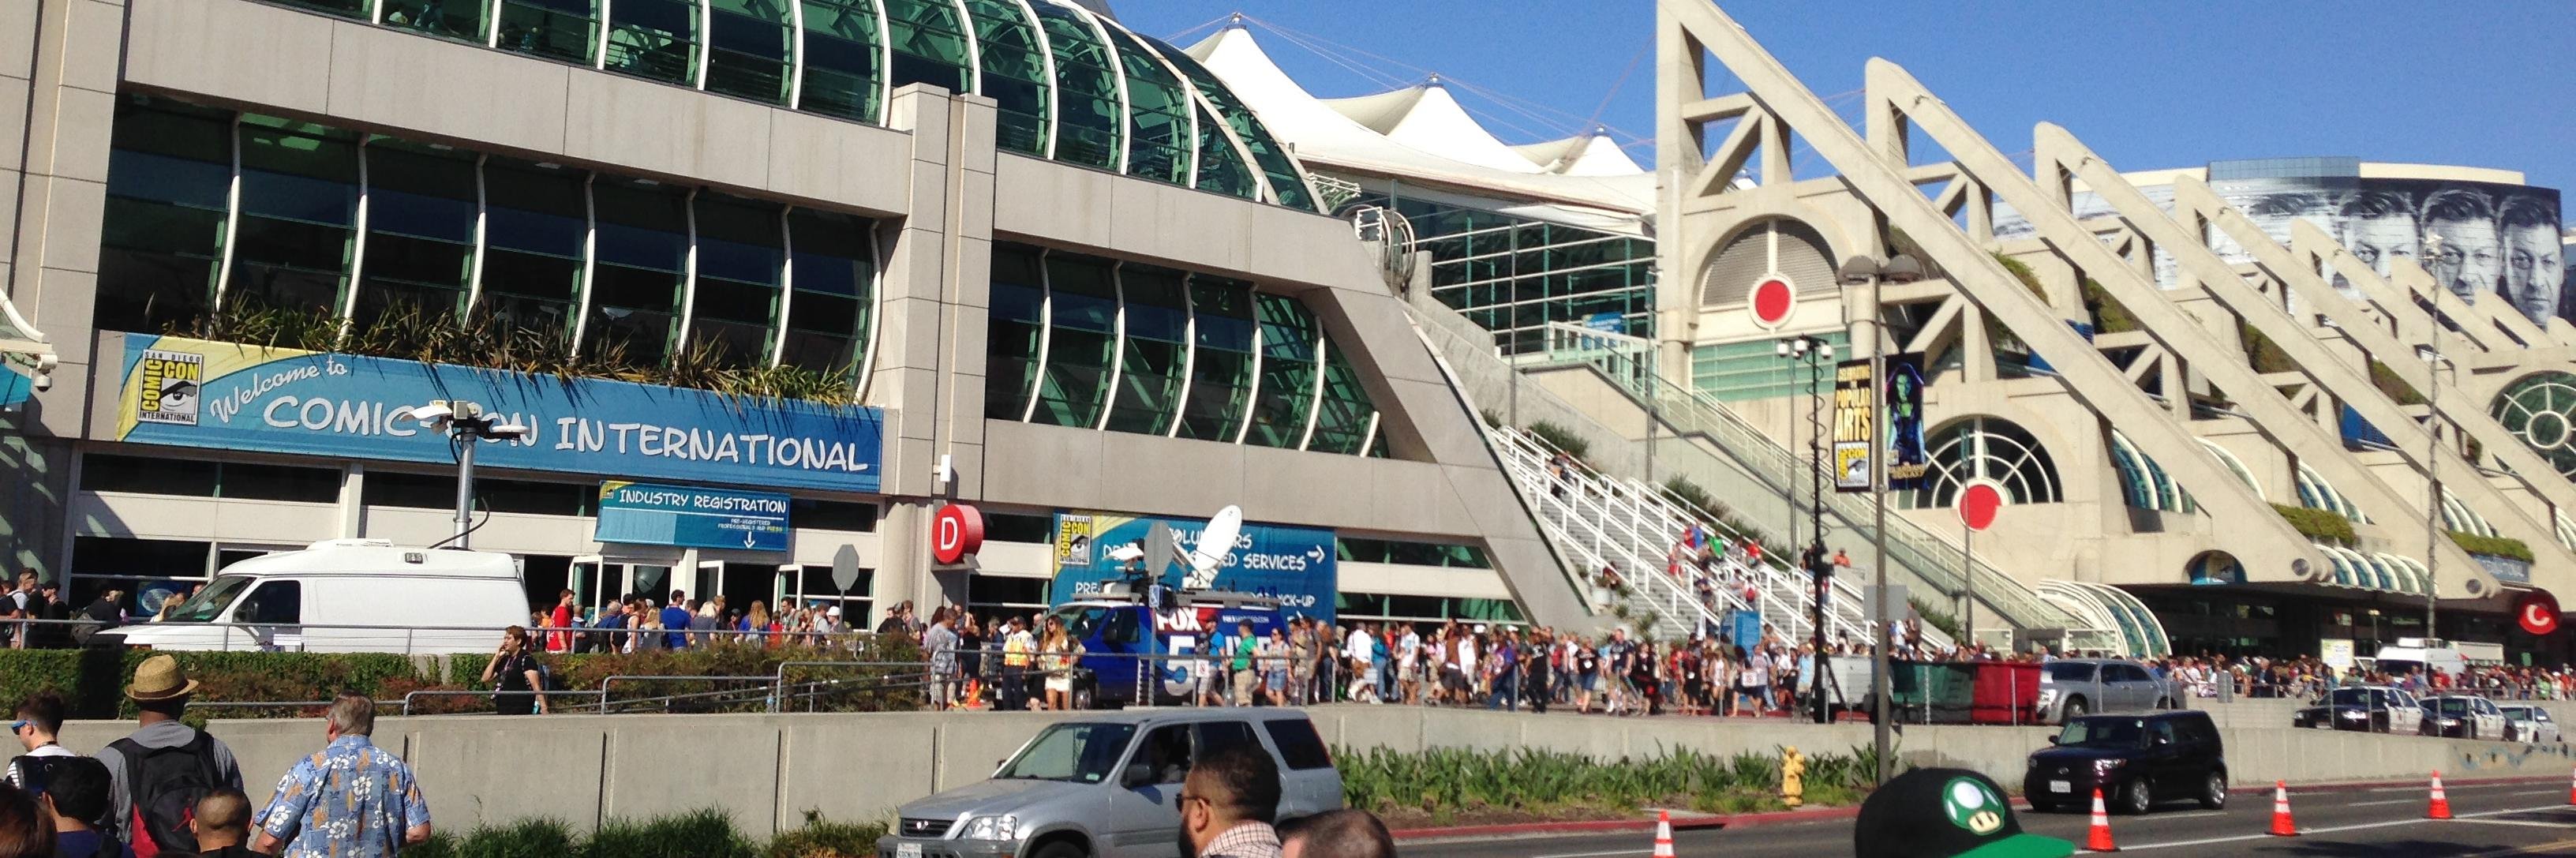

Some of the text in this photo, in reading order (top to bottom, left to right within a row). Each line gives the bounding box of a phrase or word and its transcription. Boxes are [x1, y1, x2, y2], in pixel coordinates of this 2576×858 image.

[141, 360, 163, 410] COMIC
[164, 362, 199, 380] CON
[211, 355, 347, 423] Welcome to
[139, 412, 195, 422] INTERNATIONAL
[1834, 407, 1871, 441] ARTS
[556, 417, 869, 471] INTERNATIONAL
[619, 489, 786, 513] INDUSTRY REGISTRATION
[941, 516, 958, 550] D
[1072, 522, 1089, 534] CON
[1243, 553, 1306, 571] SERVICES
